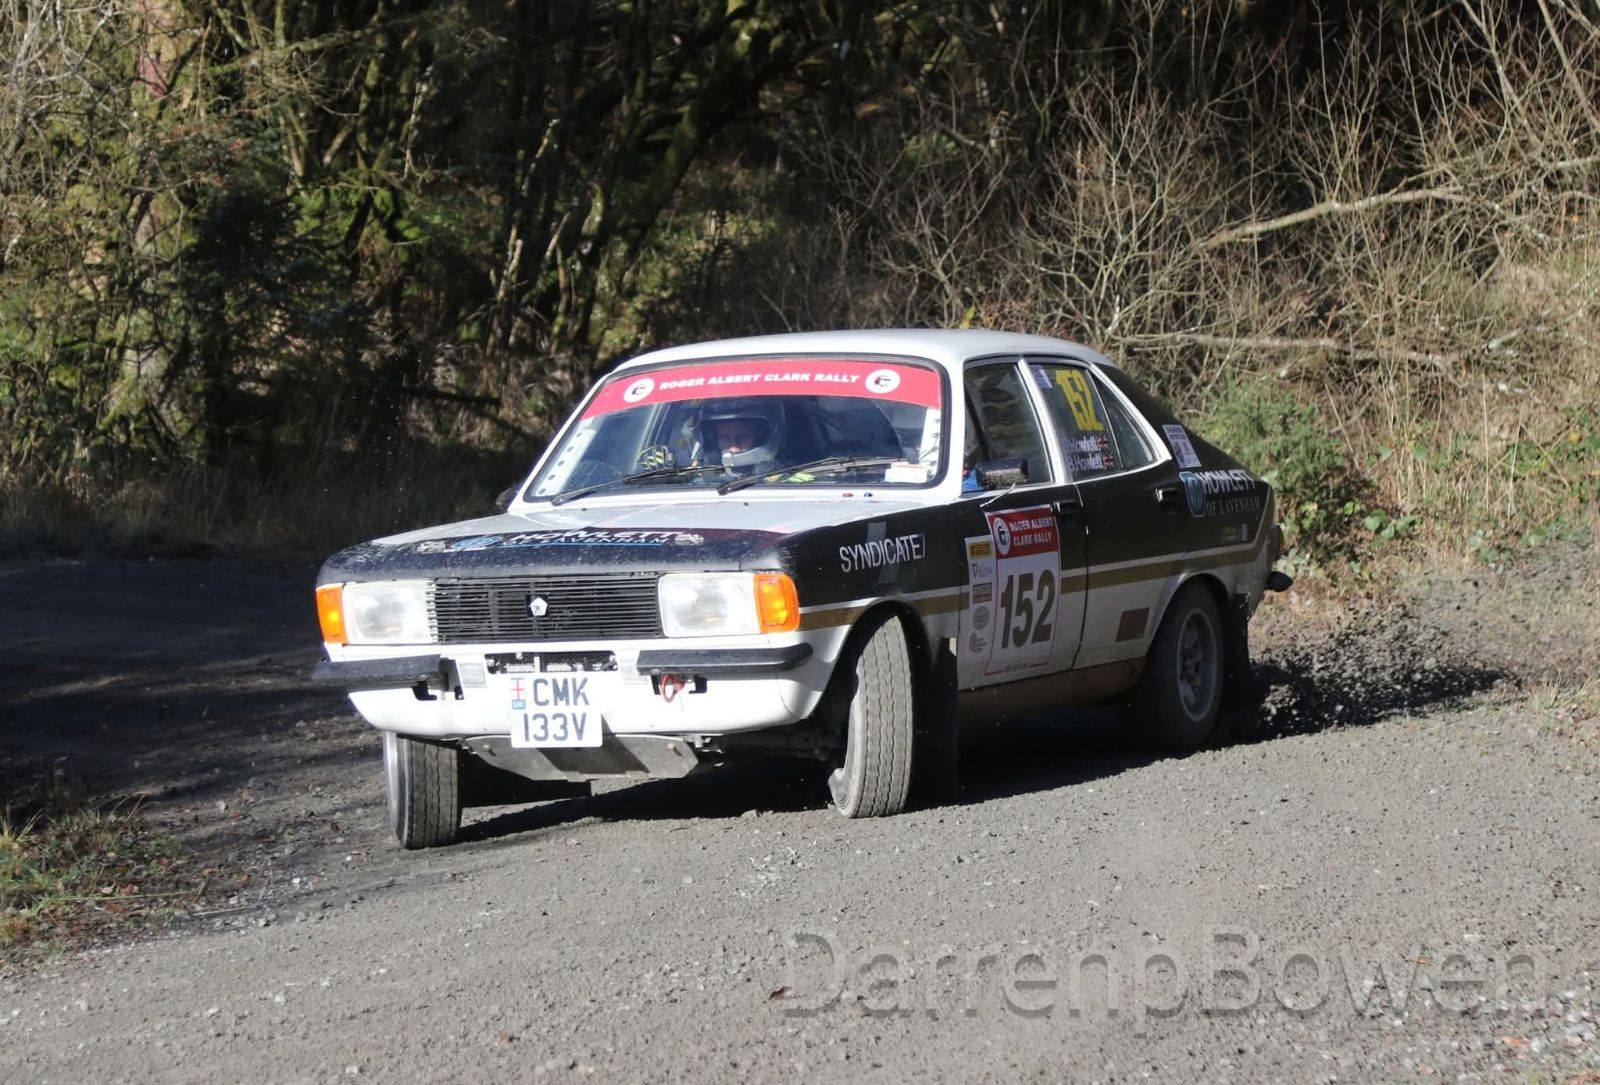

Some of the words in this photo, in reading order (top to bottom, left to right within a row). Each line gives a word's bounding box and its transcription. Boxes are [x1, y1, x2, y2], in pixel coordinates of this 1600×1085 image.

[658, 378, 705, 391] ROGER
[706, 373, 762, 386] ALBERT
[763, 373, 811, 383] CLARK
[813, 373, 861, 384] RALLY
[1055, 370, 1104, 430] 152
[1196, 469, 1255, 494] HOWLETT
[1206, 500, 1217, 517] OF
[507, 531, 681, 541] HOWLETT
[1009, 521, 1031, 532] ROGER
[1031, 517, 1053, 530] ALBERT
[1013, 535, 1032, 547] CLARK
[1034, 531, 1052, 544] RALLY
[839, 534, 922, 573] SYNDICATE
[1000, 569, 1056, 649] 152
[533, 677, 590, 707] CMK
[523, 713, 587, 742] 133V
